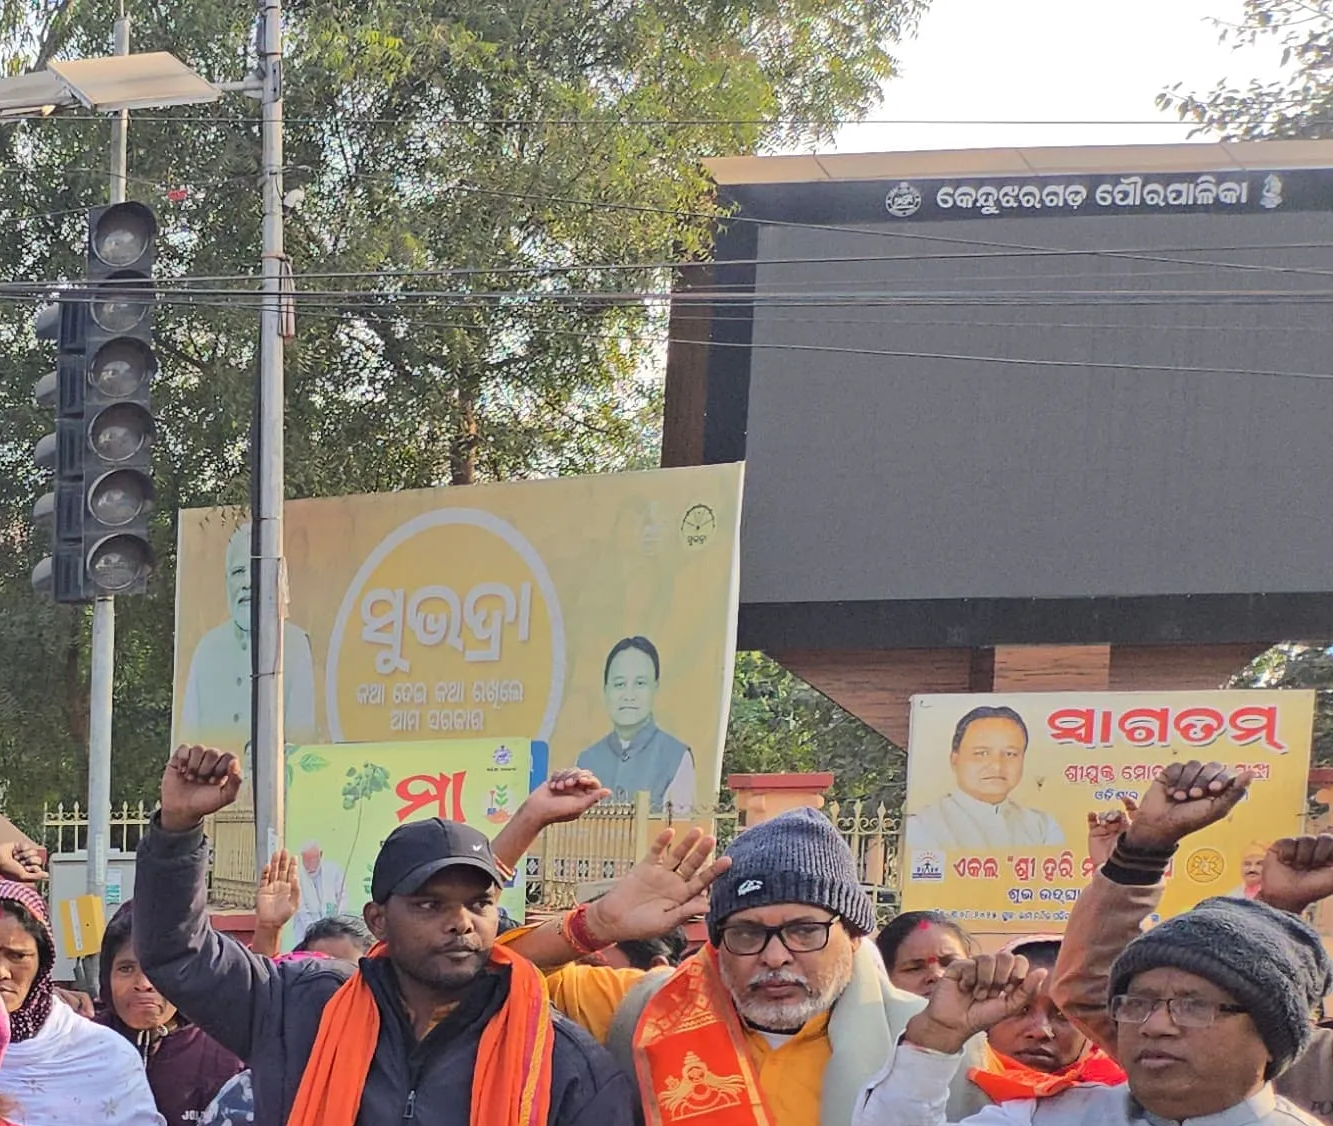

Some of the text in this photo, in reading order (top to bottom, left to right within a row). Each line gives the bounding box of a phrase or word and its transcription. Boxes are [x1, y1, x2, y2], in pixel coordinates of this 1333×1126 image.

[1095, 174, 1248, 207] ପୌରପାଳିକା
[361, 581, 532, 675] ସୁଭଦ୍ରା
[389, 710, 420, 731] ଆମ
[395, 770, 467, 824] ମା
